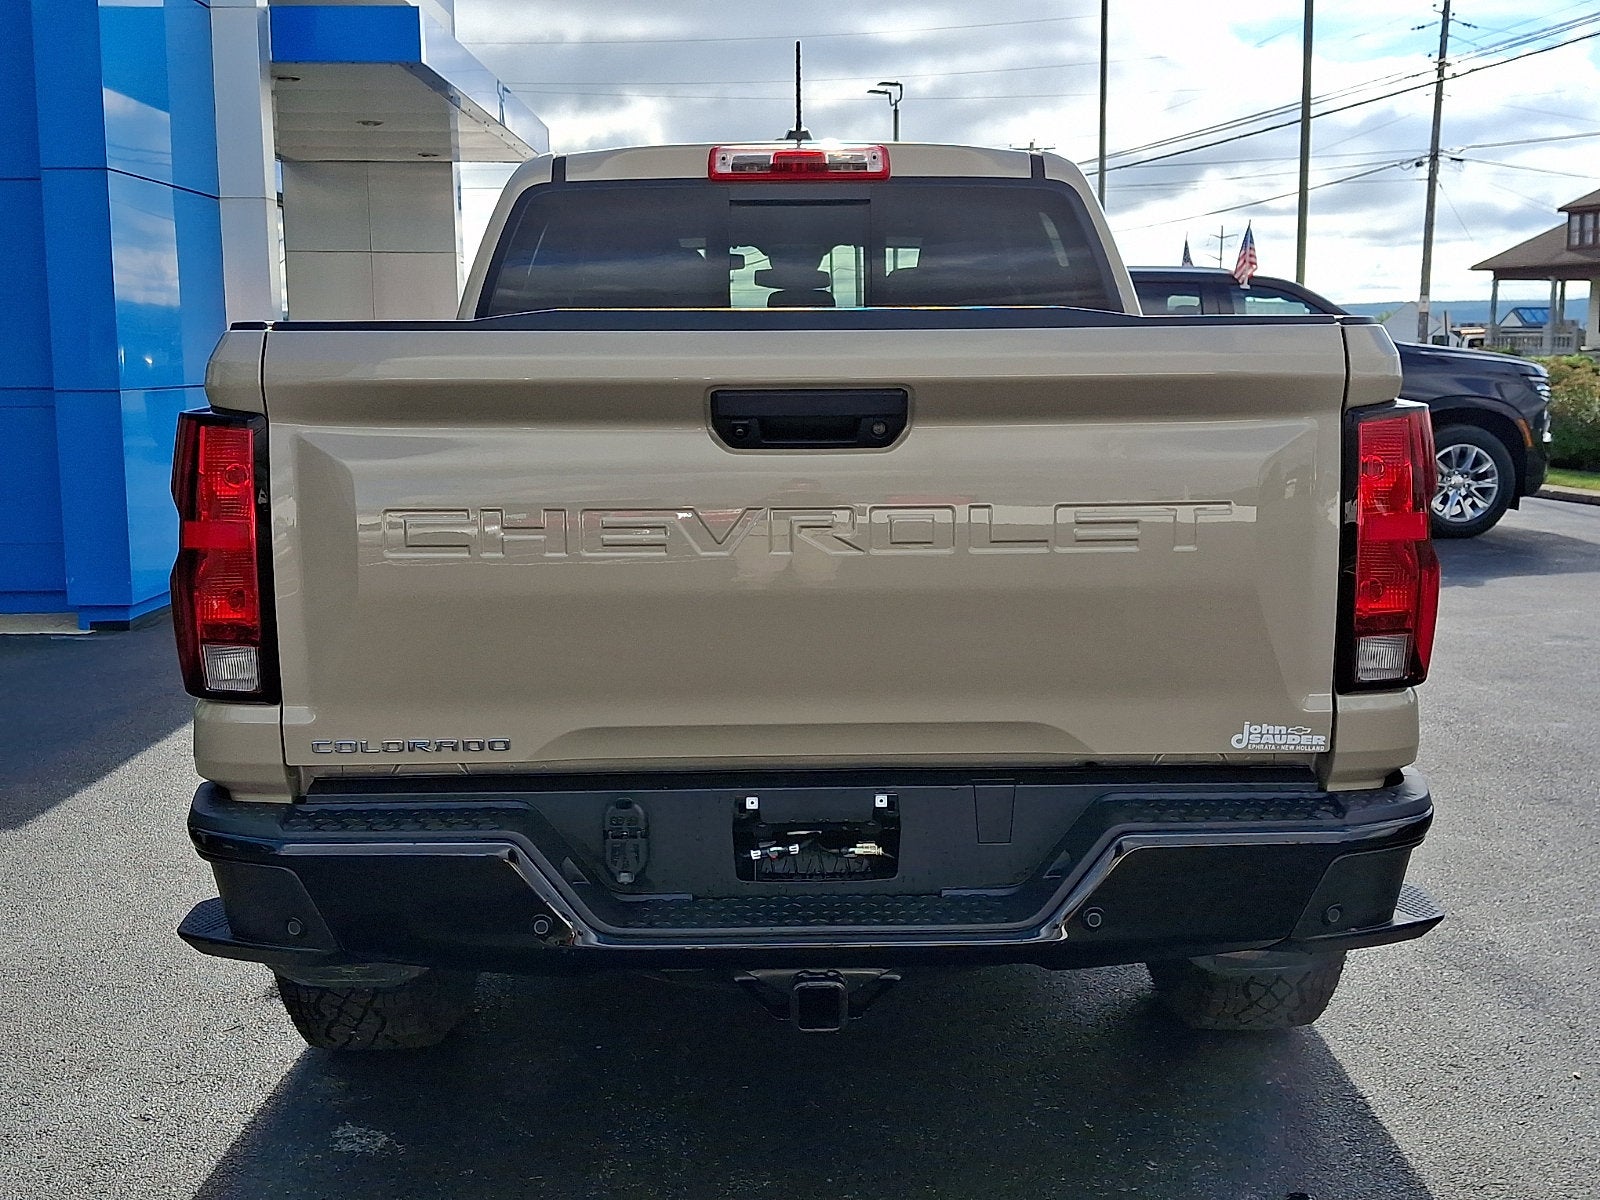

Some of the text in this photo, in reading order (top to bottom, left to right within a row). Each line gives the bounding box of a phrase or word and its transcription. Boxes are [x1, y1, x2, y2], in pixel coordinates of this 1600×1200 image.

[381, 501, 1234, 558] CHEVROLET
[311, 738, 511, 754] COLORADO
[1248, 734, 1326, 745] SAUDER
